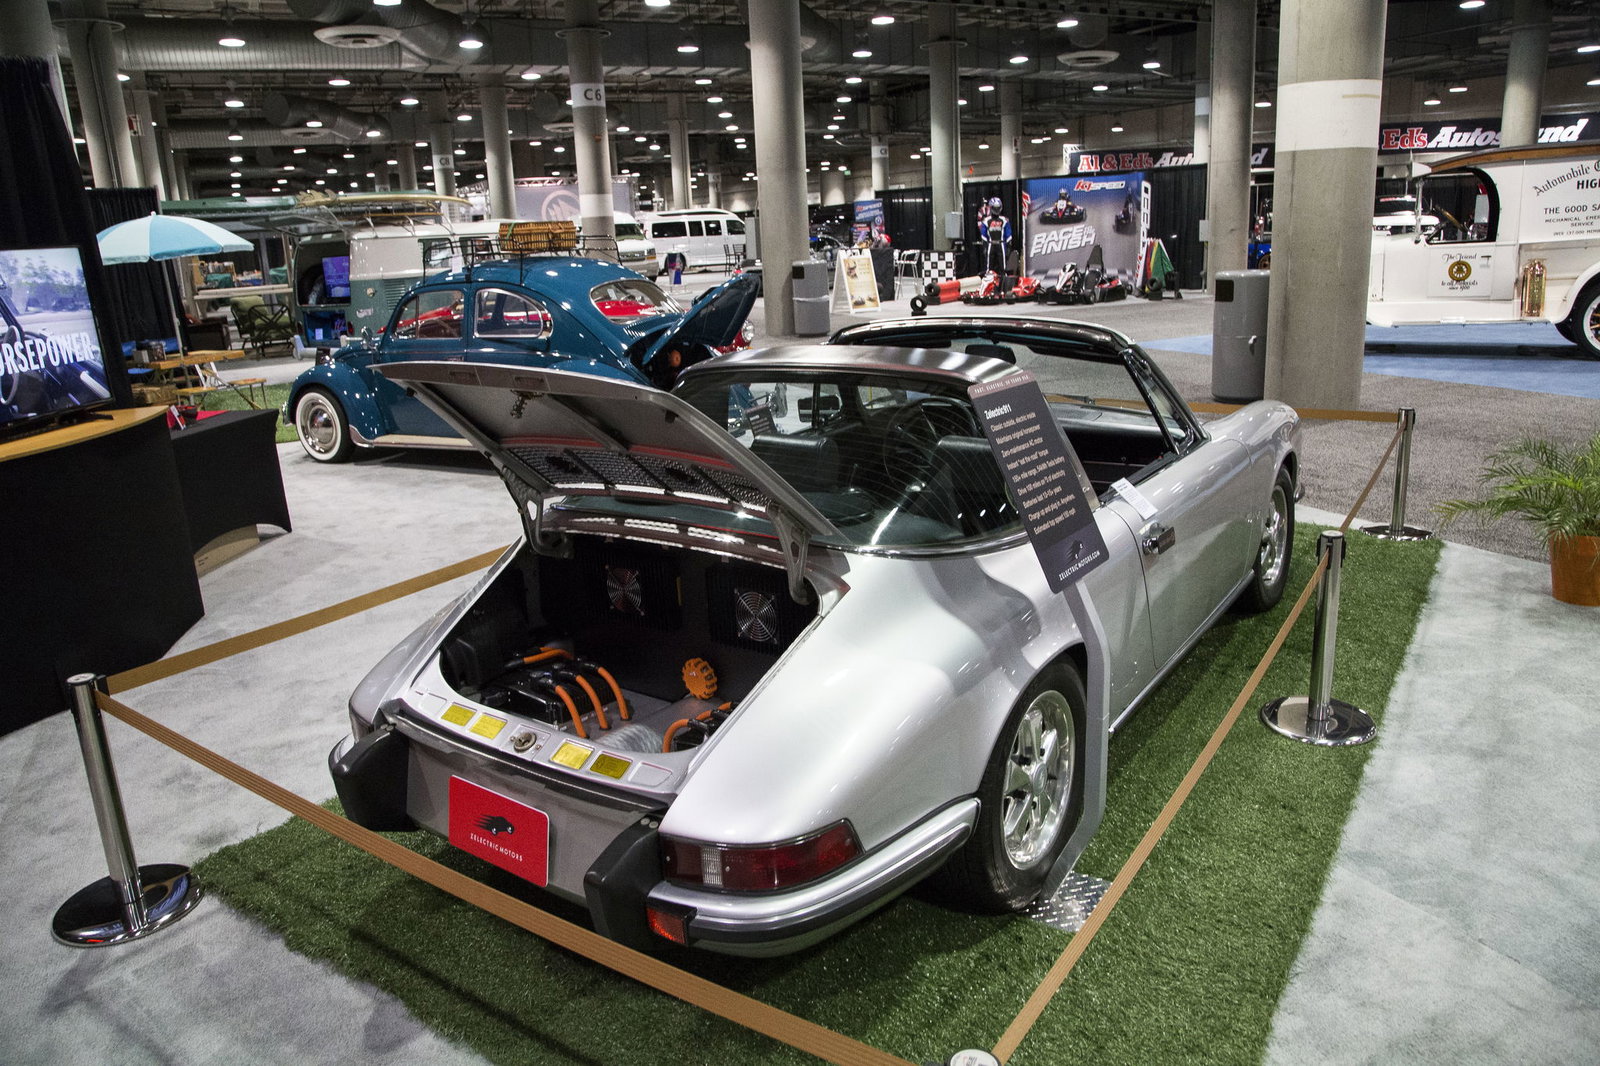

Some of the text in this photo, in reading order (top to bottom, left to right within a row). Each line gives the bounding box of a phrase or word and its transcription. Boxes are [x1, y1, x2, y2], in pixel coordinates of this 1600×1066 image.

[584, 88, 602, 101] C6
[1382, 128, 1427, 150] Ed's
[1078, 155, 1100, 172] Al
[1102, 155, 1117, 171] &
[1119, 152, 1153, 170] Ed's
[1533, 164, 1590, 196] Automobile
[1576, 179, 1600, 190] HIG
[1564, 204, 1588, 213] GOOD
[1033, 224, 1085, 241] RACE
[1030, 233, 1095, 258] FINISH
[470, 832, 522, 862] ZELECTRIC MOTORS
